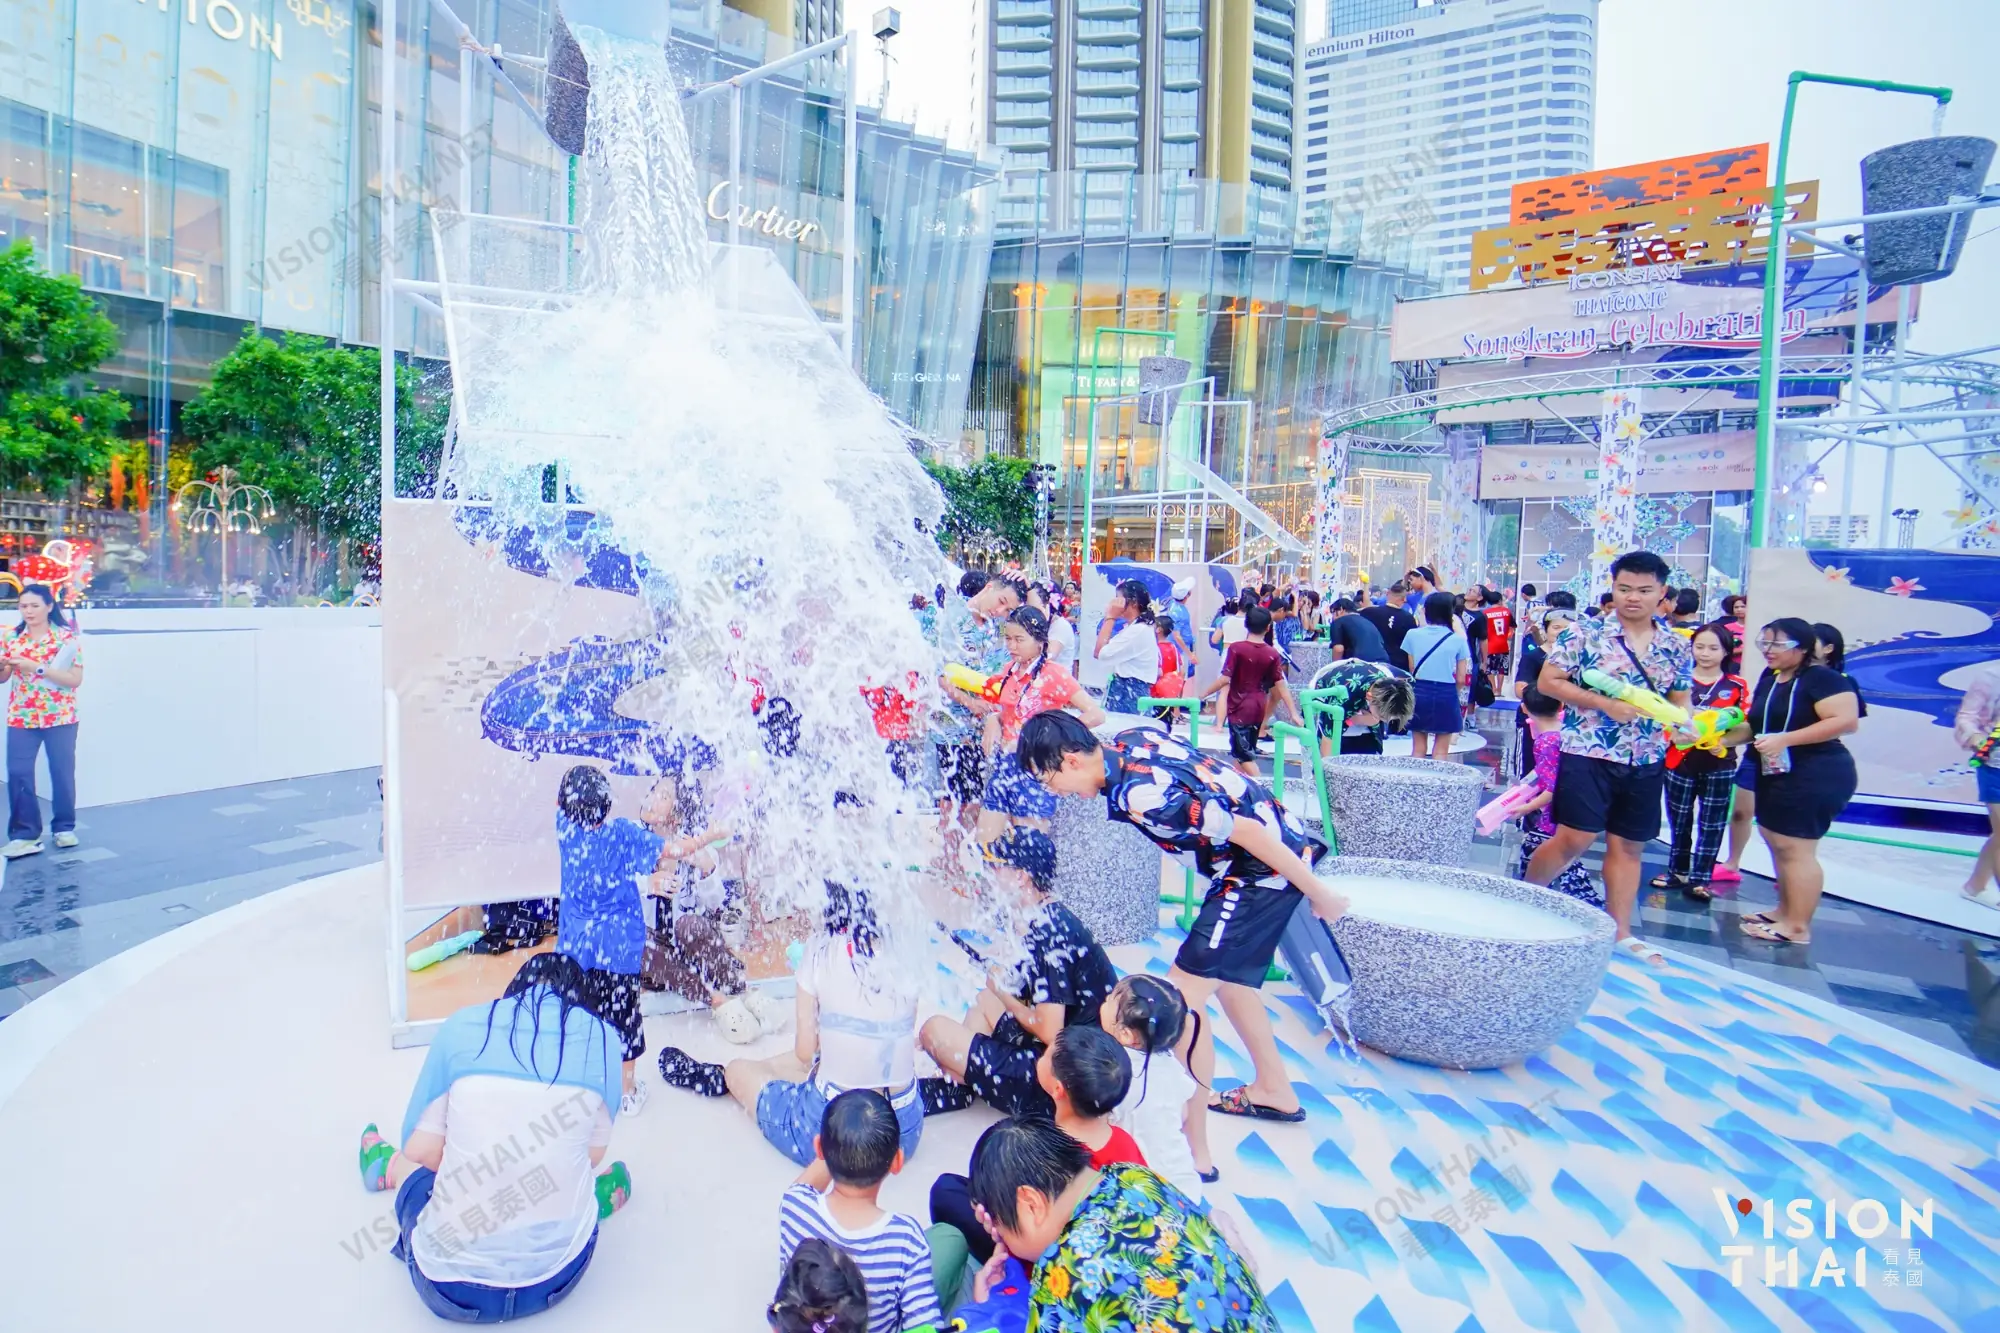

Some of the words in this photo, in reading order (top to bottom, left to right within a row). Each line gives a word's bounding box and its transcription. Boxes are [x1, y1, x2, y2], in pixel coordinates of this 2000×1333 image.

[1368, 27, 1416, 46] Hilton
[1462, 326, 1597, 361] Songkran
[1609, 308, 1806, 352] Celebratin
